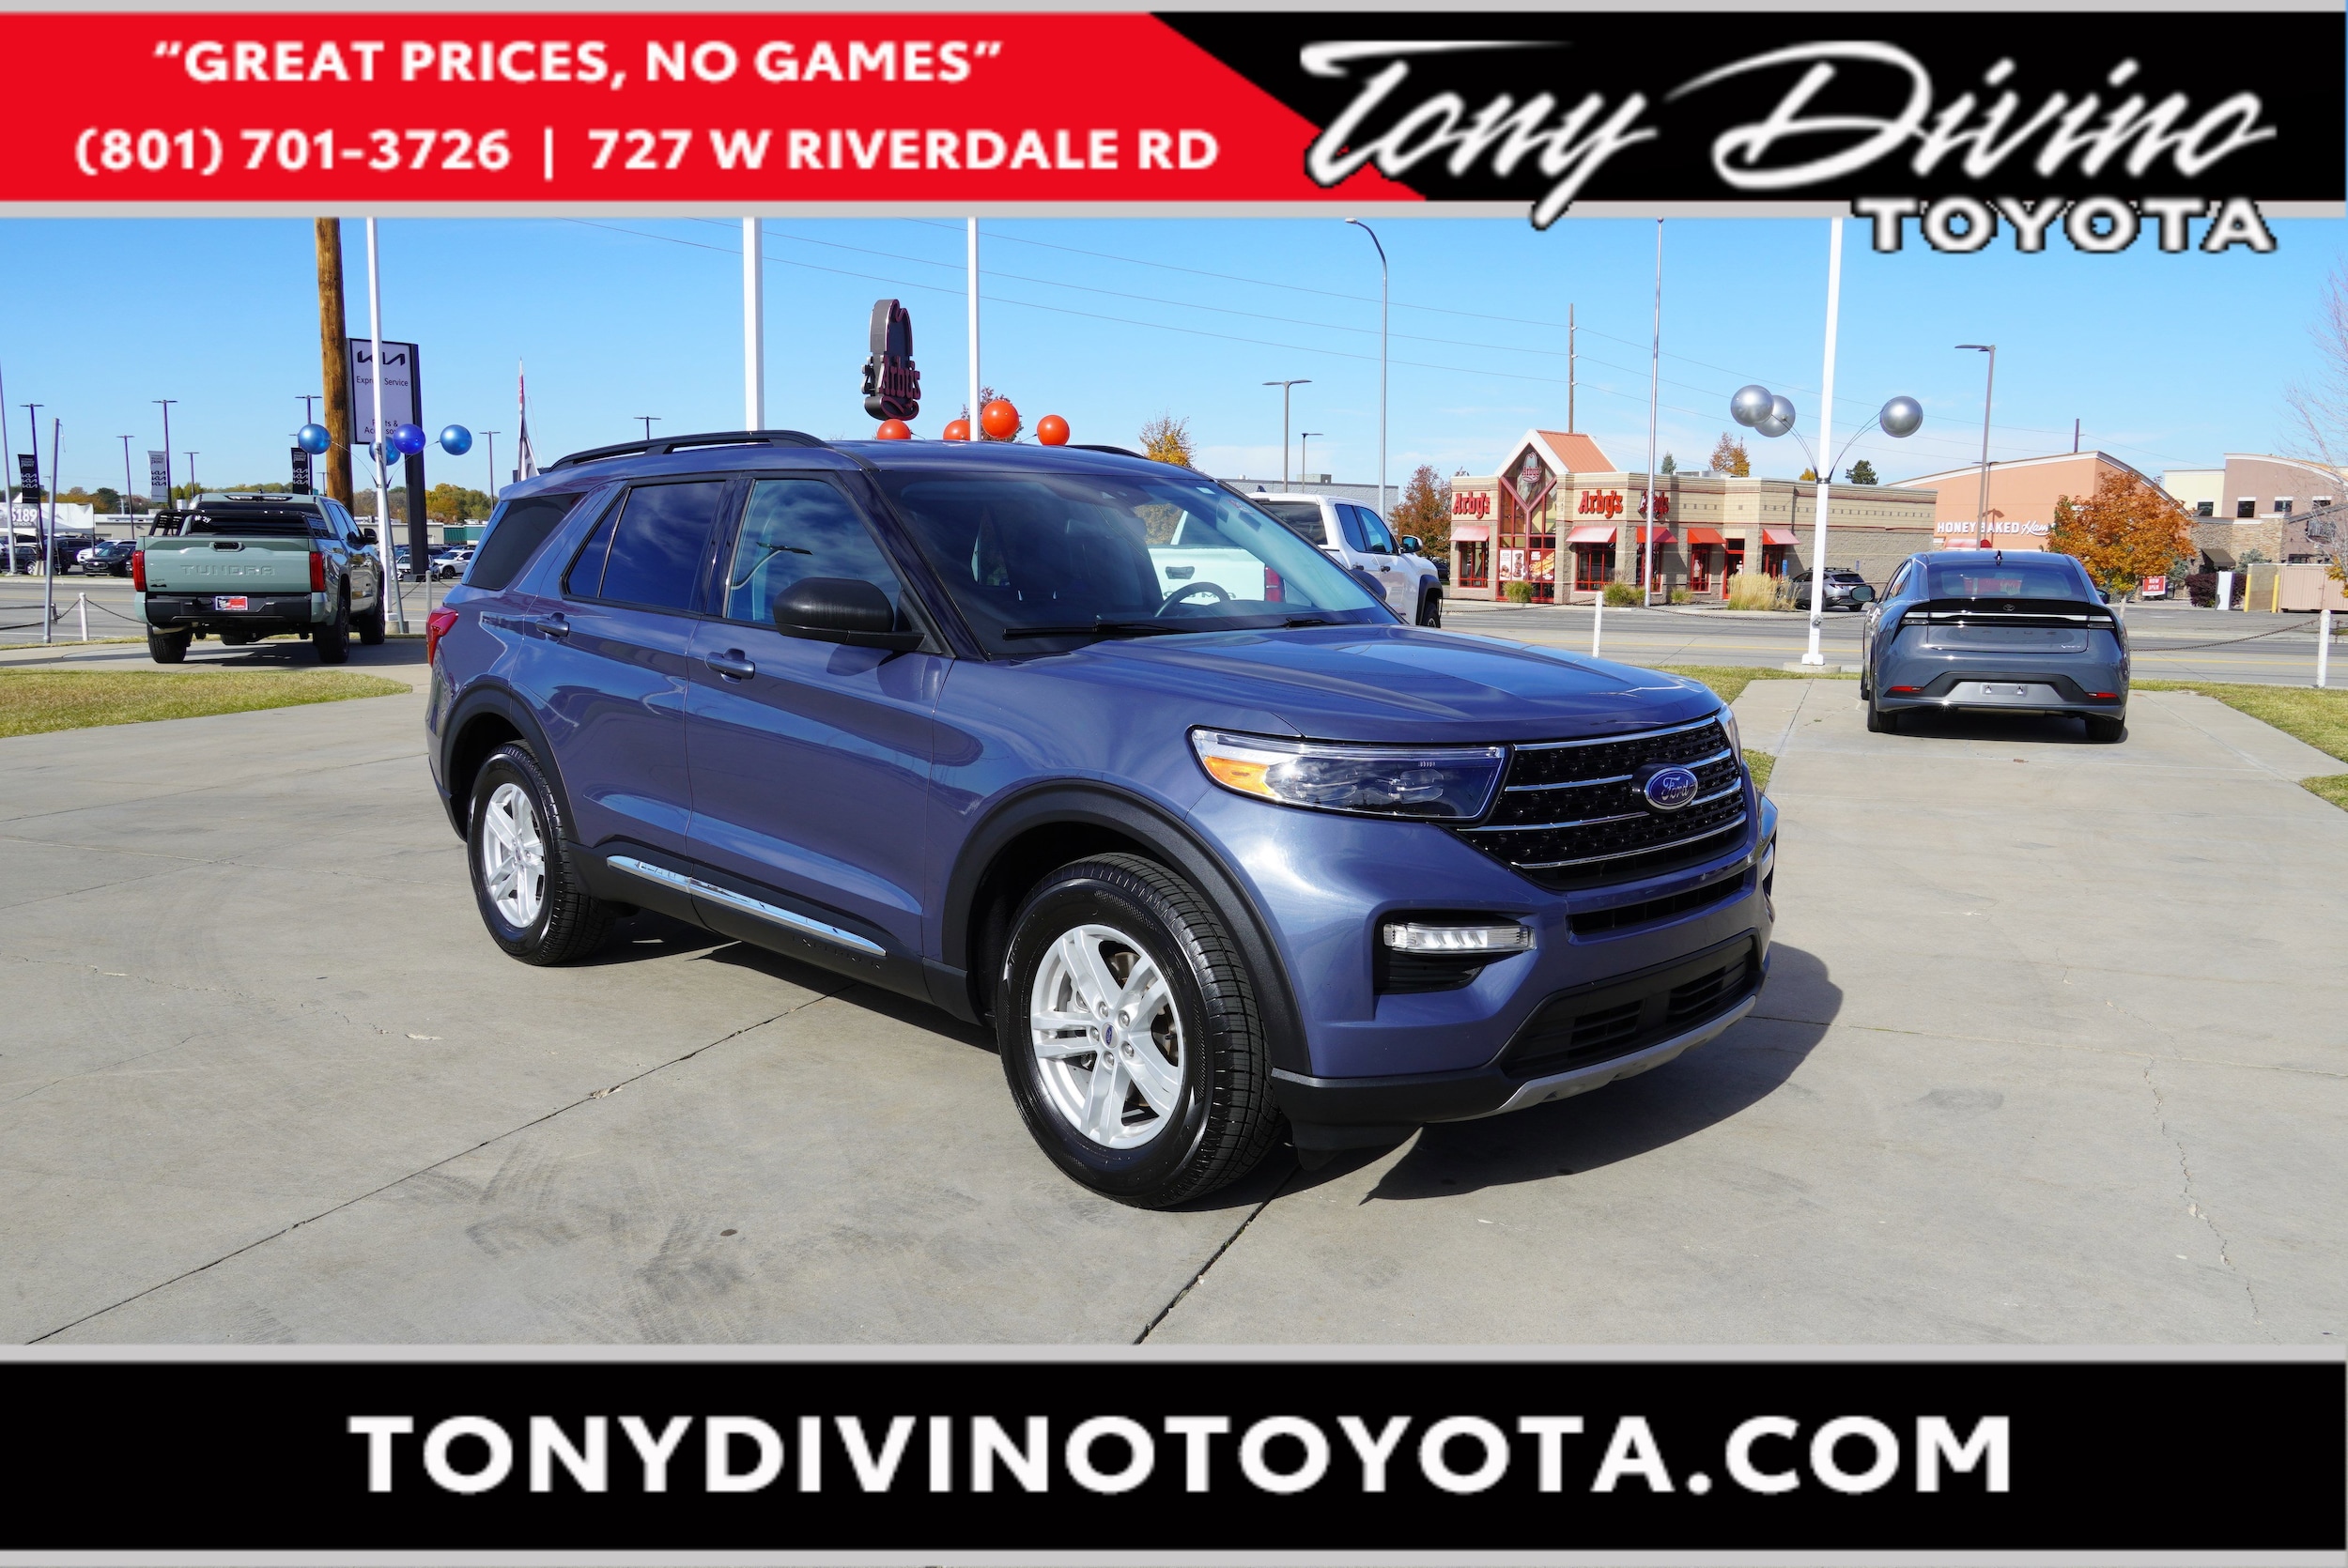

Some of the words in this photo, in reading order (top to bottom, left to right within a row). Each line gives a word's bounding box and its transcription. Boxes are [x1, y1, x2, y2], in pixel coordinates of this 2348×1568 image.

[384, 377, 409, 387] Service
[1452, 491, 1491, 519] Arby's
[1578, 489, 1624, 518] Arby's
[1638, 490, 1669, 518] Aby's
[1937, 522, 1977, 533] HONEY
[180, 564, 275, 576] TUNDRA
[1661, 776, 1690, 801] Ford
